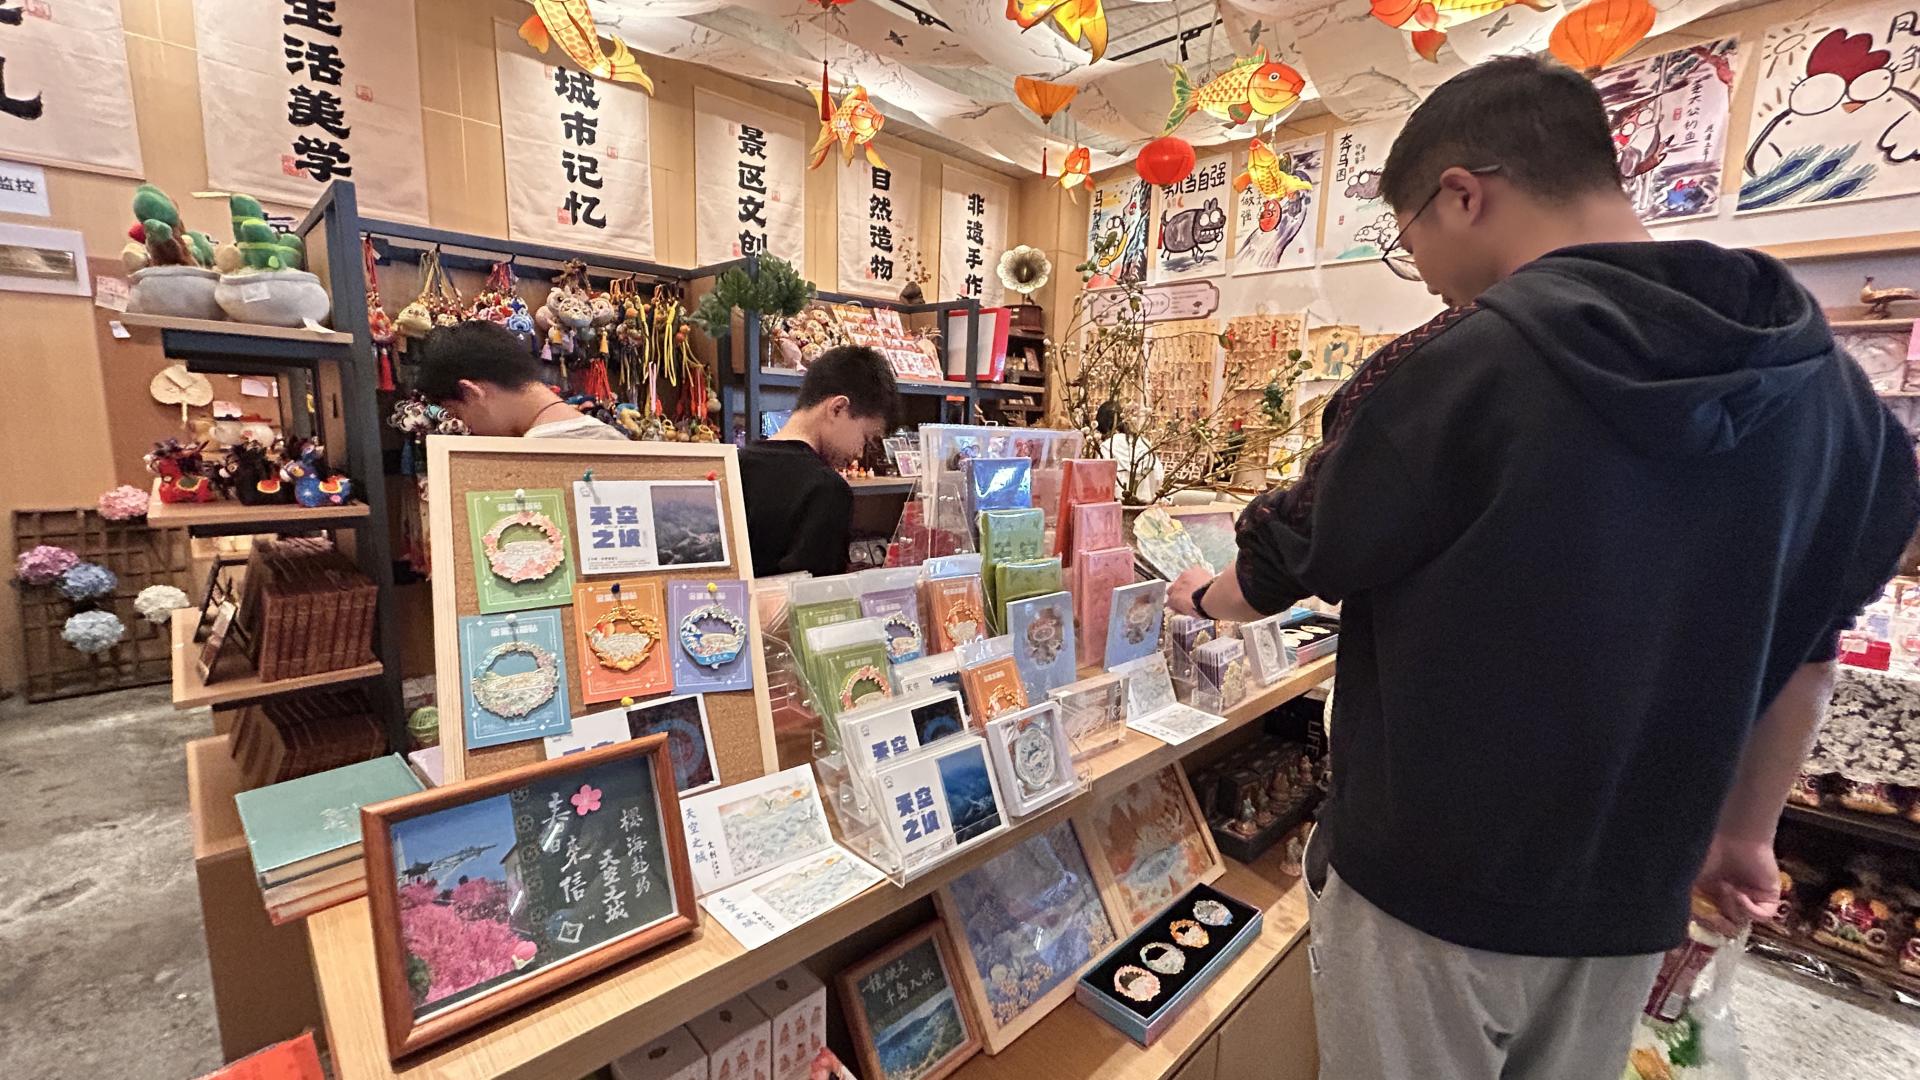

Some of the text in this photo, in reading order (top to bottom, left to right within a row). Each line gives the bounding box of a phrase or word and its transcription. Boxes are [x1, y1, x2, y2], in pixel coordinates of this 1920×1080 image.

[283, 0, 352, 182] 生活美学
[554, 66, 608, 229] 城市记忆
[738, 124, 768, 257] 景区文创
[869, 167, 893, 282] 自然造物
[965, 193, 985, 297] 非遗手作
